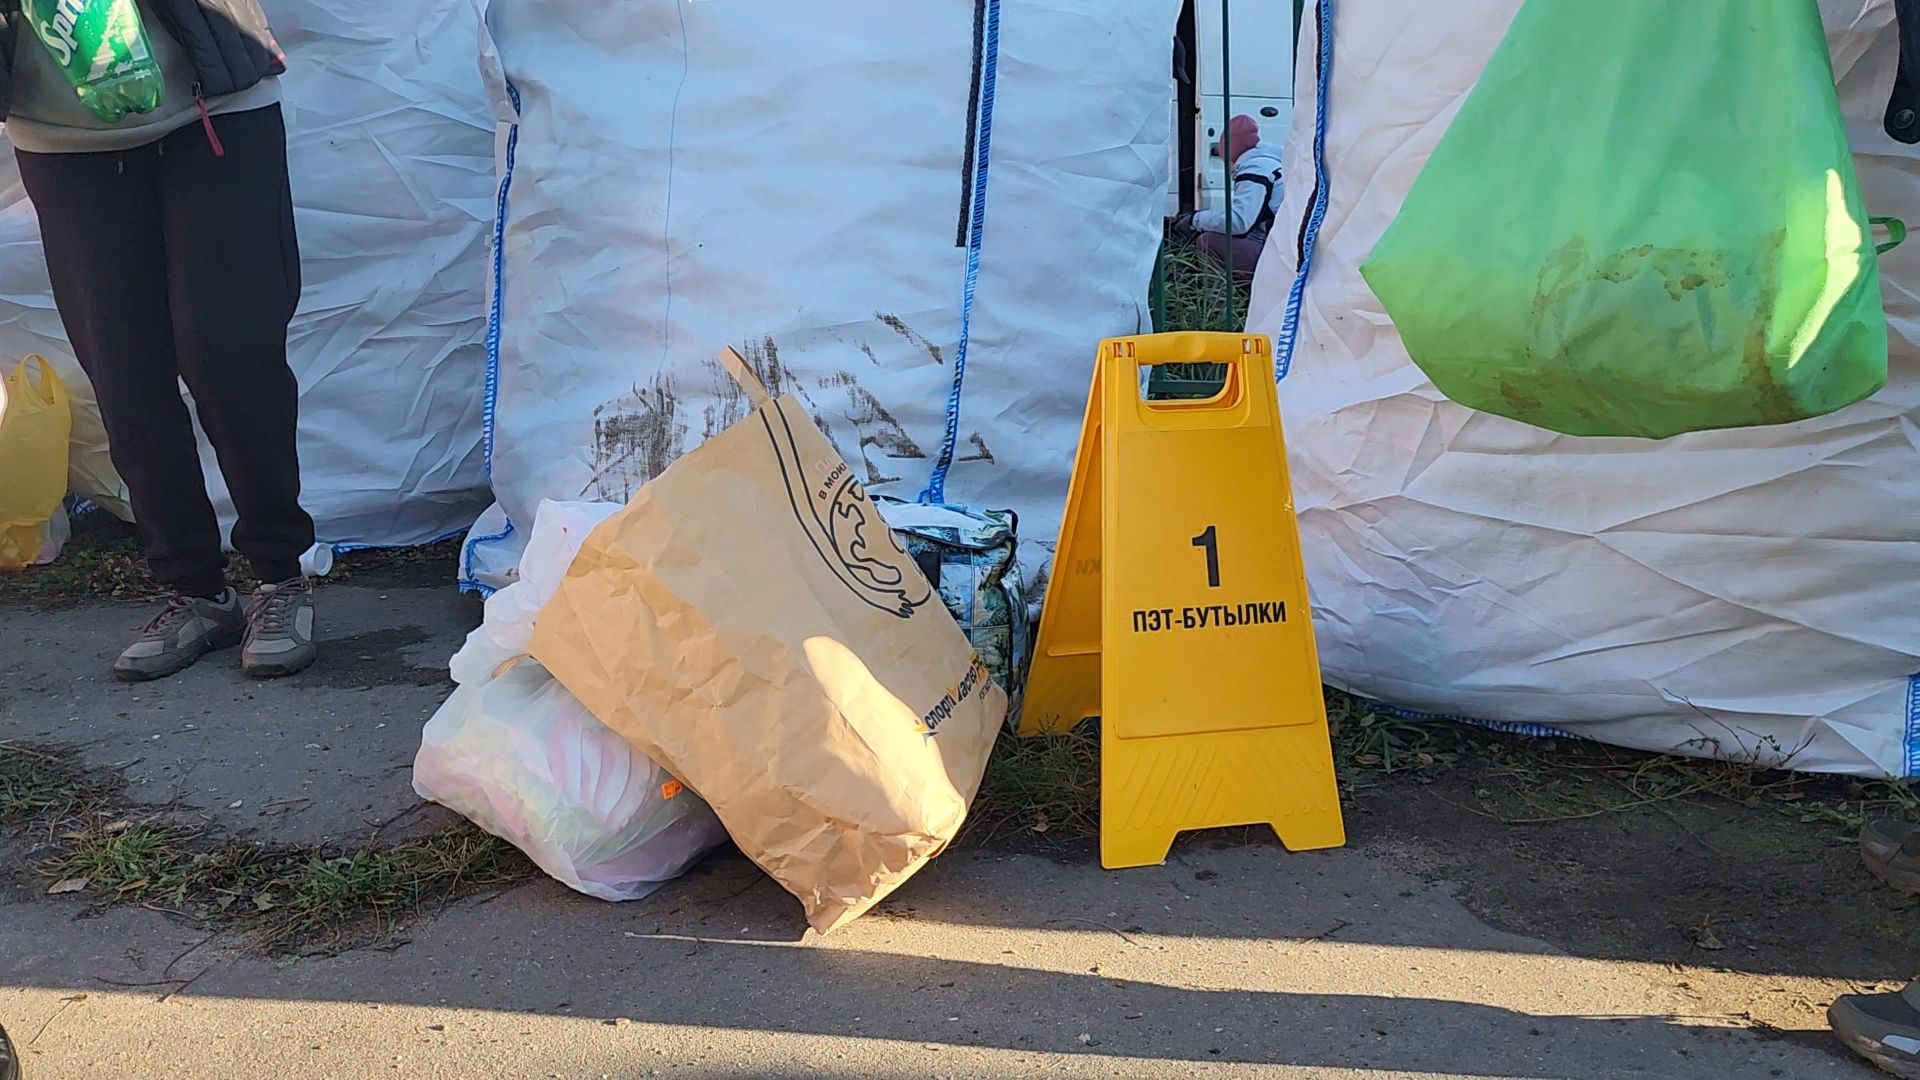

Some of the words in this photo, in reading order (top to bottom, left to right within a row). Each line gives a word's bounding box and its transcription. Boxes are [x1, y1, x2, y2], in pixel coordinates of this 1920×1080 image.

[818, 489, 828, 500] В
[1191, 525, 1221, 588] 1
[1133, 601, 1287, 634] ПЭТ-БУТЫЛКИ
